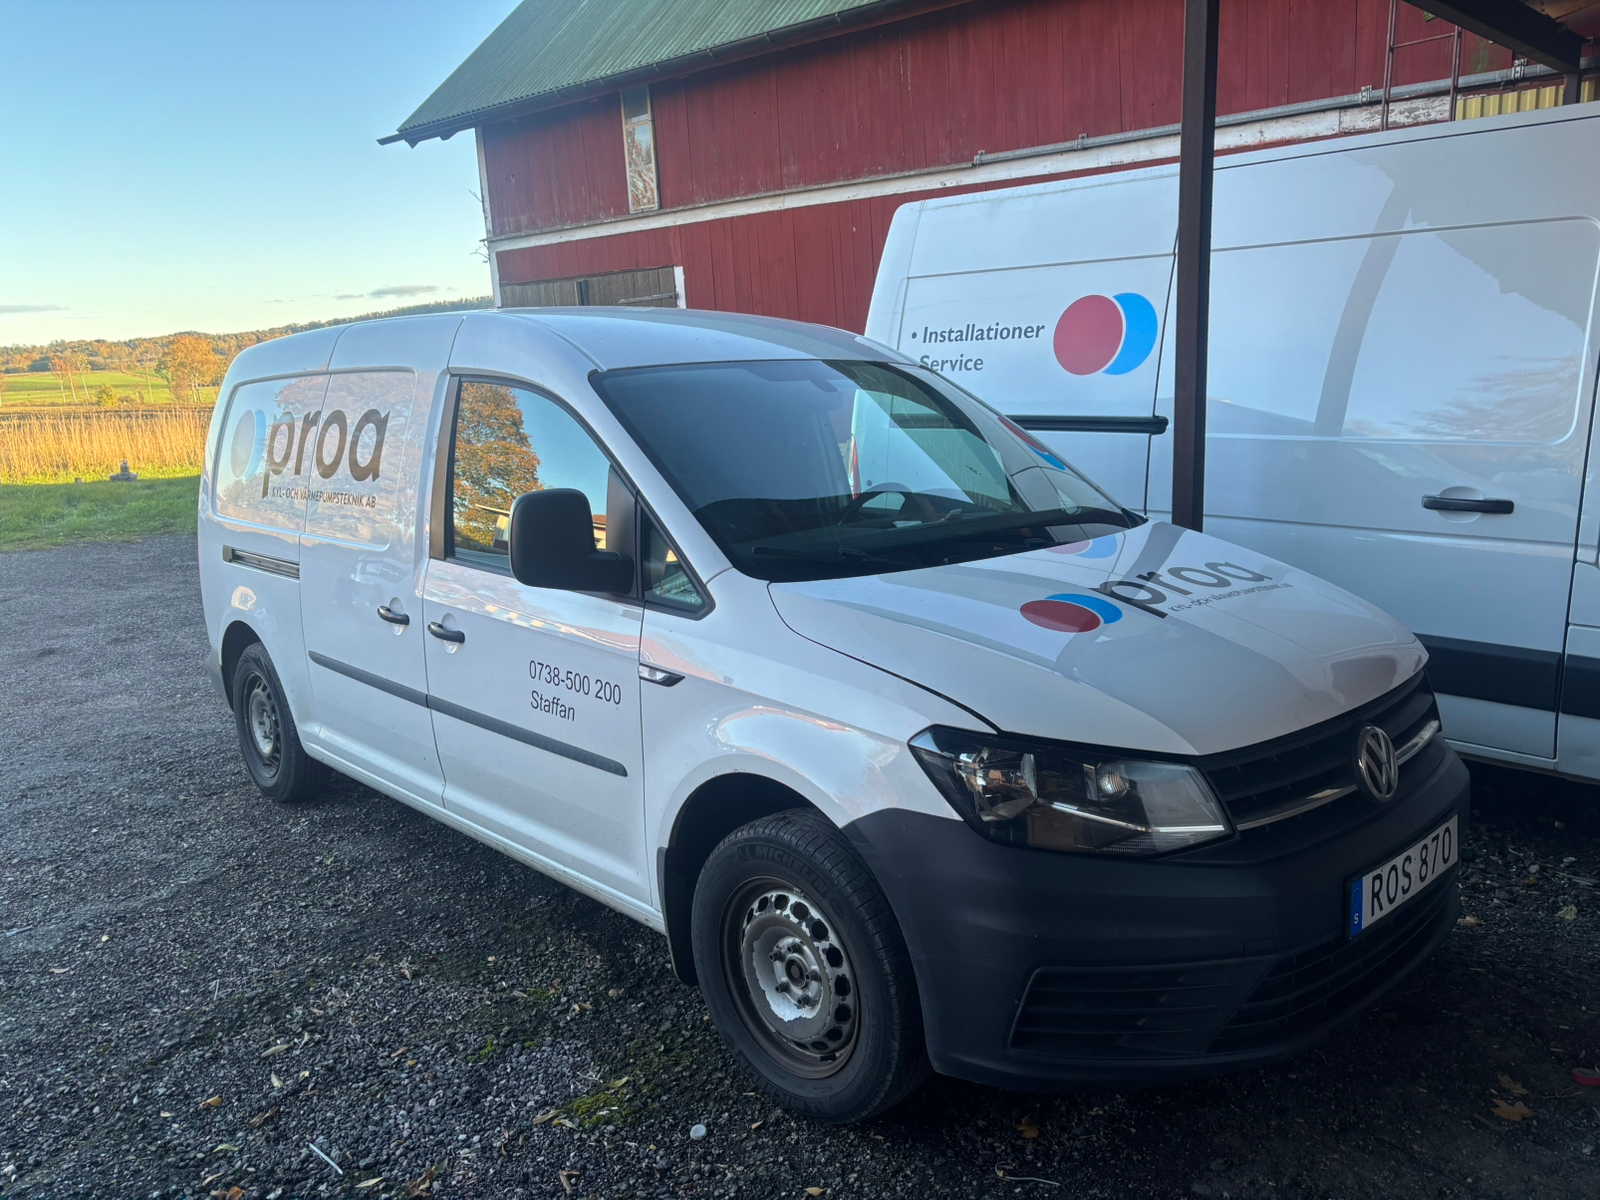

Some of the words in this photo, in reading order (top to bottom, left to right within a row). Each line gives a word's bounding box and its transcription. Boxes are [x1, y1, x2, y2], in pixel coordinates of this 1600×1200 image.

[922, 322, 1045, 344] Installationer
[920, 354, 984, 372] Service
[261, 408, 391, 499] proa
[285, 487, 299, 500] OCH
[299, 487, 365, 507] VÄRMEPUMPSTEKNIK
[365, 495, 377, 508] AB
[1088, 561, 1273, 619] proa
[529, 660, 591, 695] 0738-500
[594, 679, 621, 705] 200
[530, 690, 575, 721] Staffan
[1371, 854, 1412, 917] ROS
[1419, 826, 1453, 884] 870
[1353, 912, 1360, 925] S
